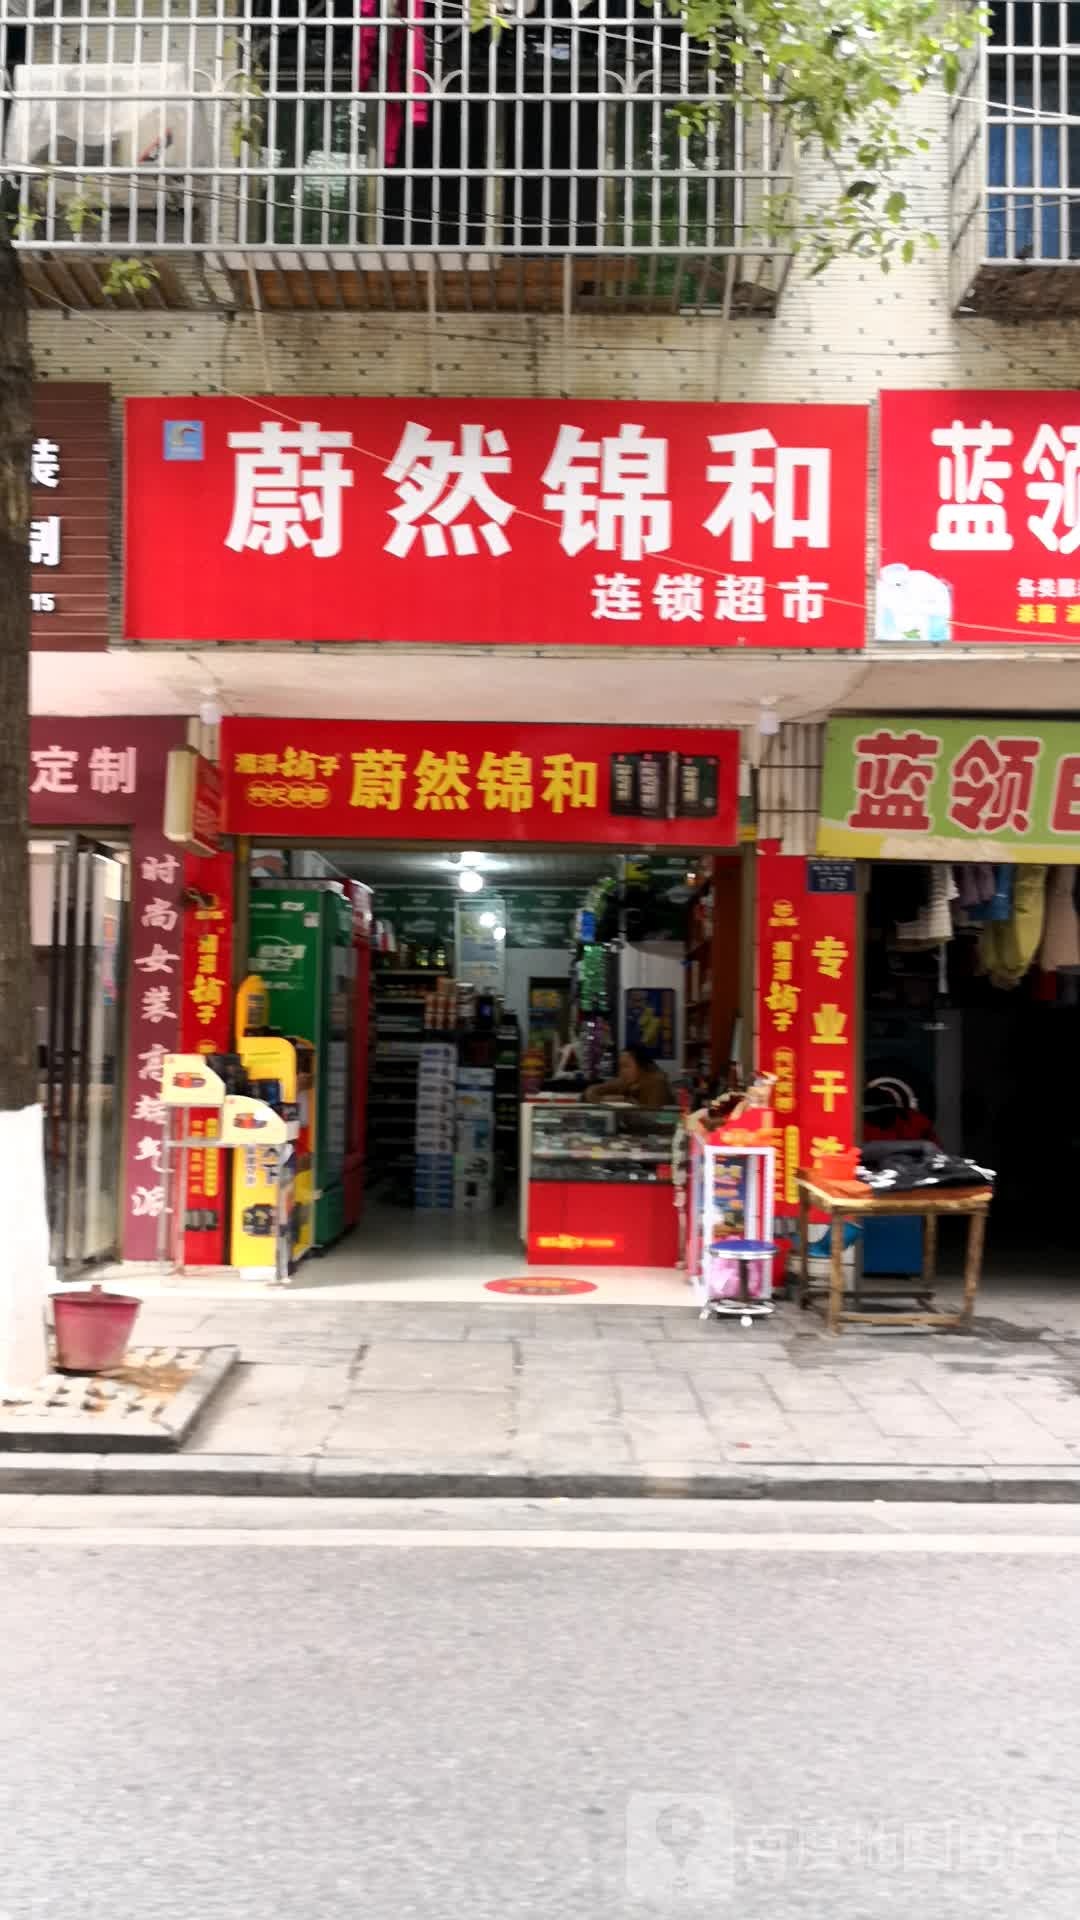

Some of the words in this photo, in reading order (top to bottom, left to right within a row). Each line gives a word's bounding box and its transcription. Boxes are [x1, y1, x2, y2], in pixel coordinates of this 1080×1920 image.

[224, 421, 831, 562] 蔚然锦和
[591, 572, 829, 623] 连锁超市
[29, 745, 137, 794] 定制
[349, 748, 599, 813] 蔚然锦和
[134, 854, 181, 1023] 时尚女装
